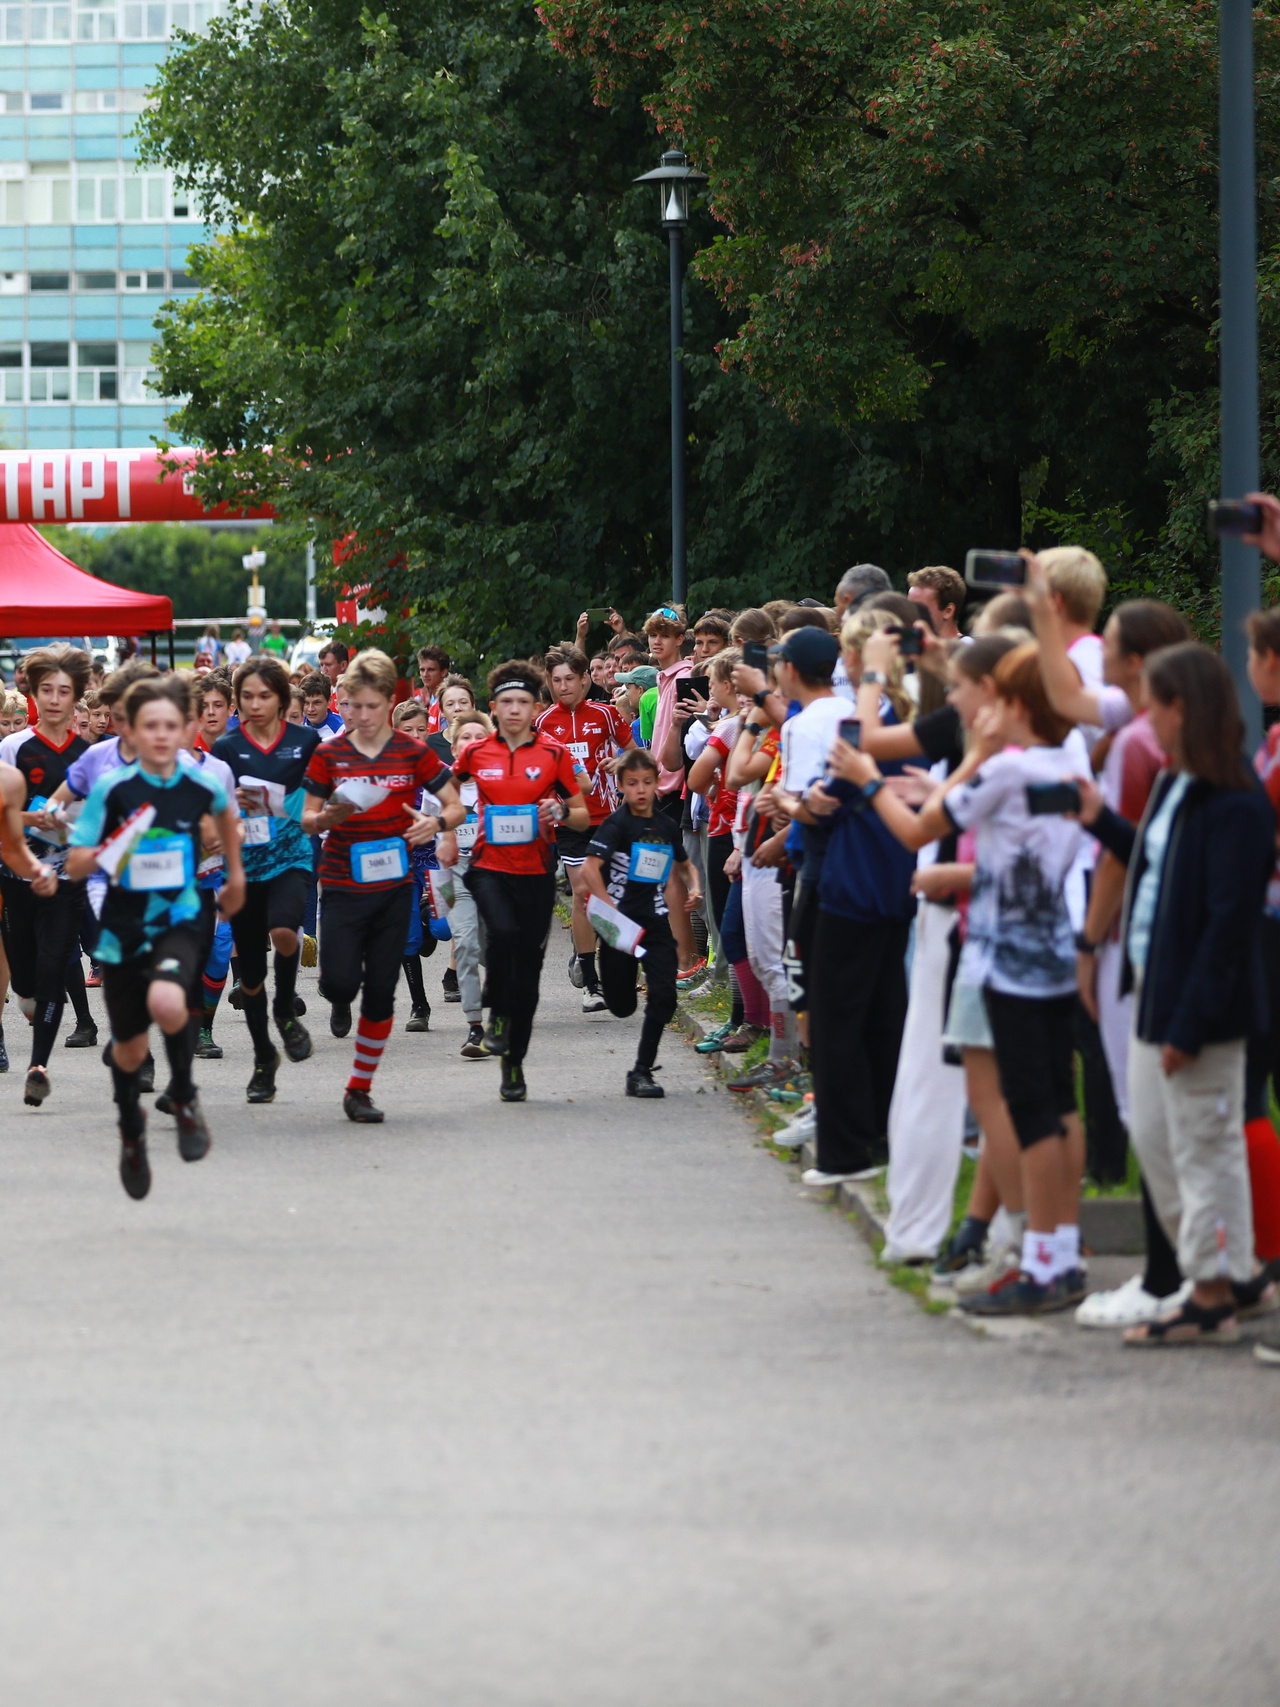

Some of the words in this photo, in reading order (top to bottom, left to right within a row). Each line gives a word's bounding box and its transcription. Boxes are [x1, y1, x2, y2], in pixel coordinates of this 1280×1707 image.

[374, 775, 414, 787] WEST
[454, 827, 476, 836] 323.1
[499, 824, 524, 834] 321.1
